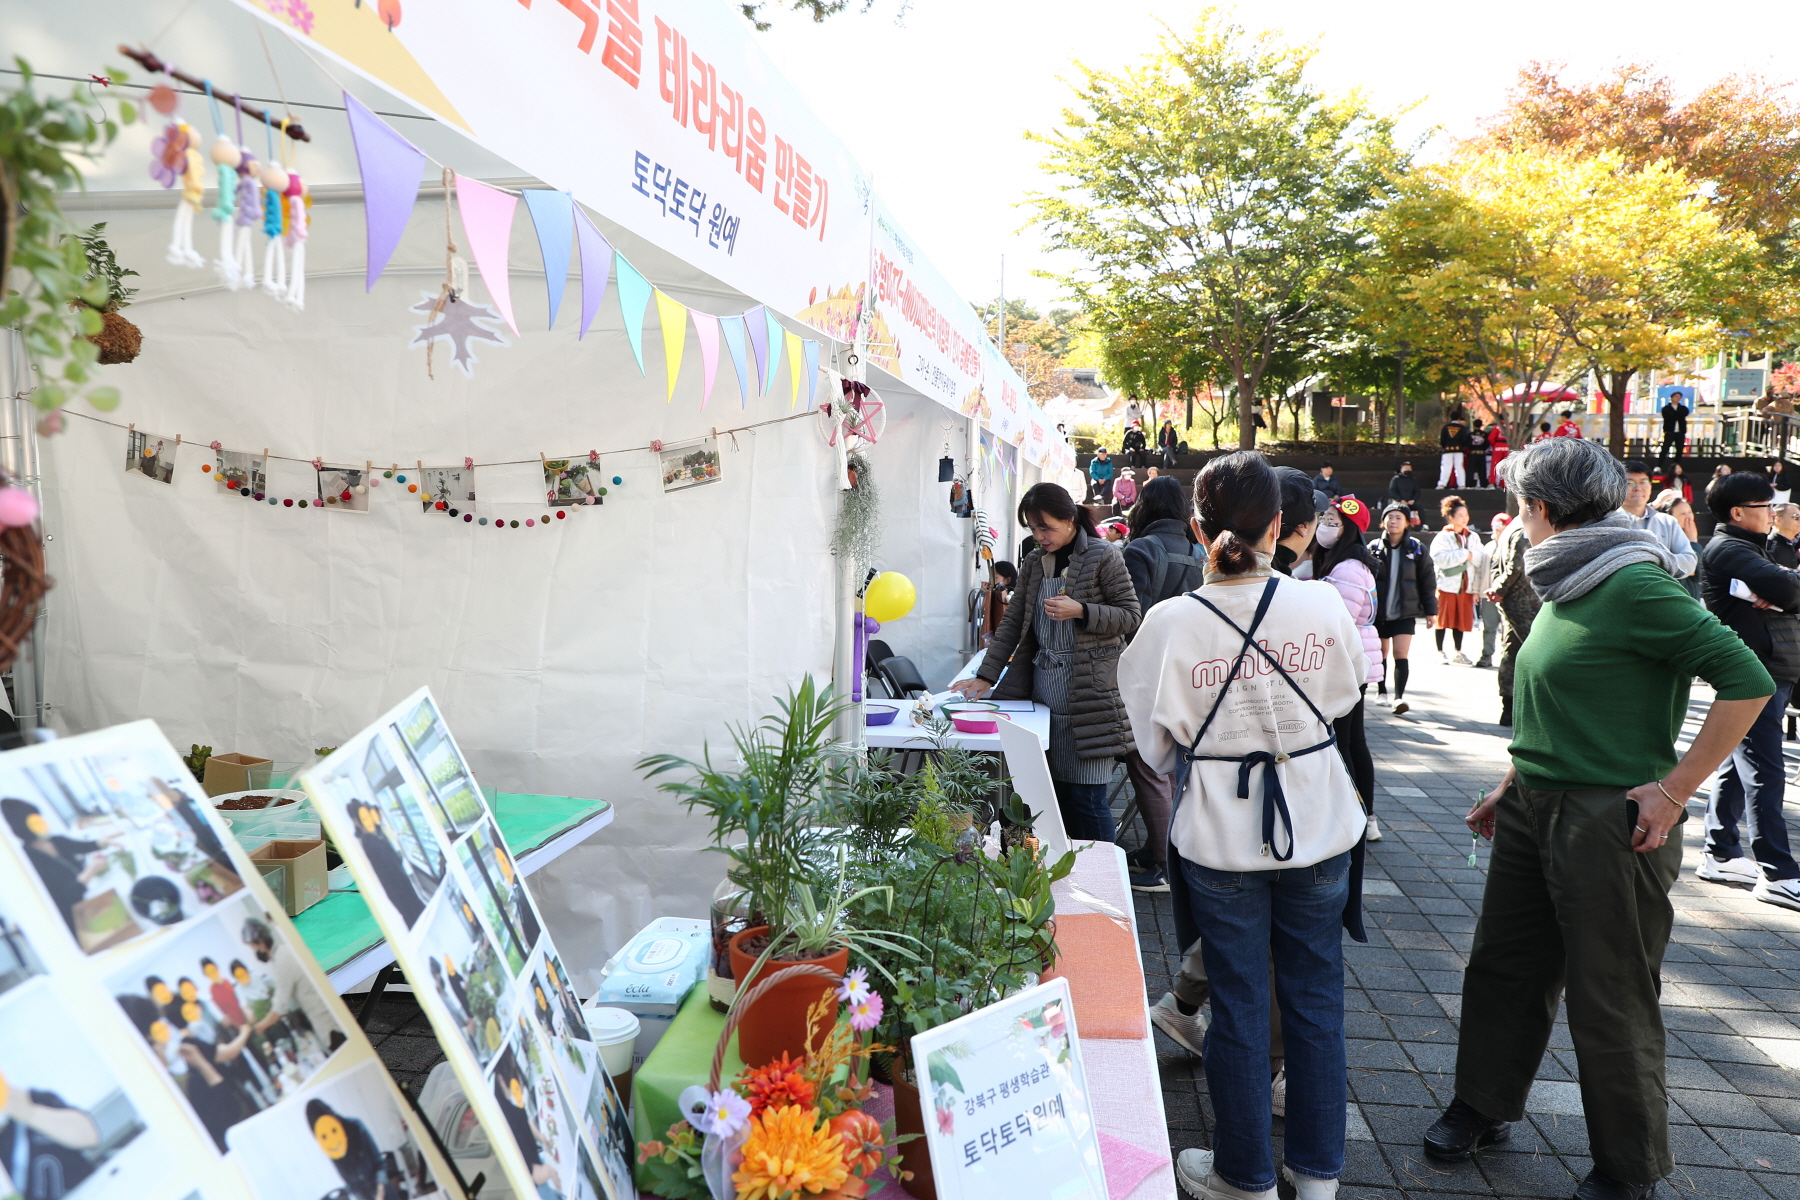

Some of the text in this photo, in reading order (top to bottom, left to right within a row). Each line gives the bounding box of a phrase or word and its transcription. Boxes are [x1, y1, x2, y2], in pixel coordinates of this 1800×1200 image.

[655, 14, 767, 194] 테라리움
[773, 133, 829, 243] 만들기
[631, 149, 741, 257] 토닥토닥 원예
[1343, 501, 1358, 513] 32
[1211, 676, 1310, 699] DSIGN STUIO
[964, 1061, 1050, 1117] 강북구 평생학습관
